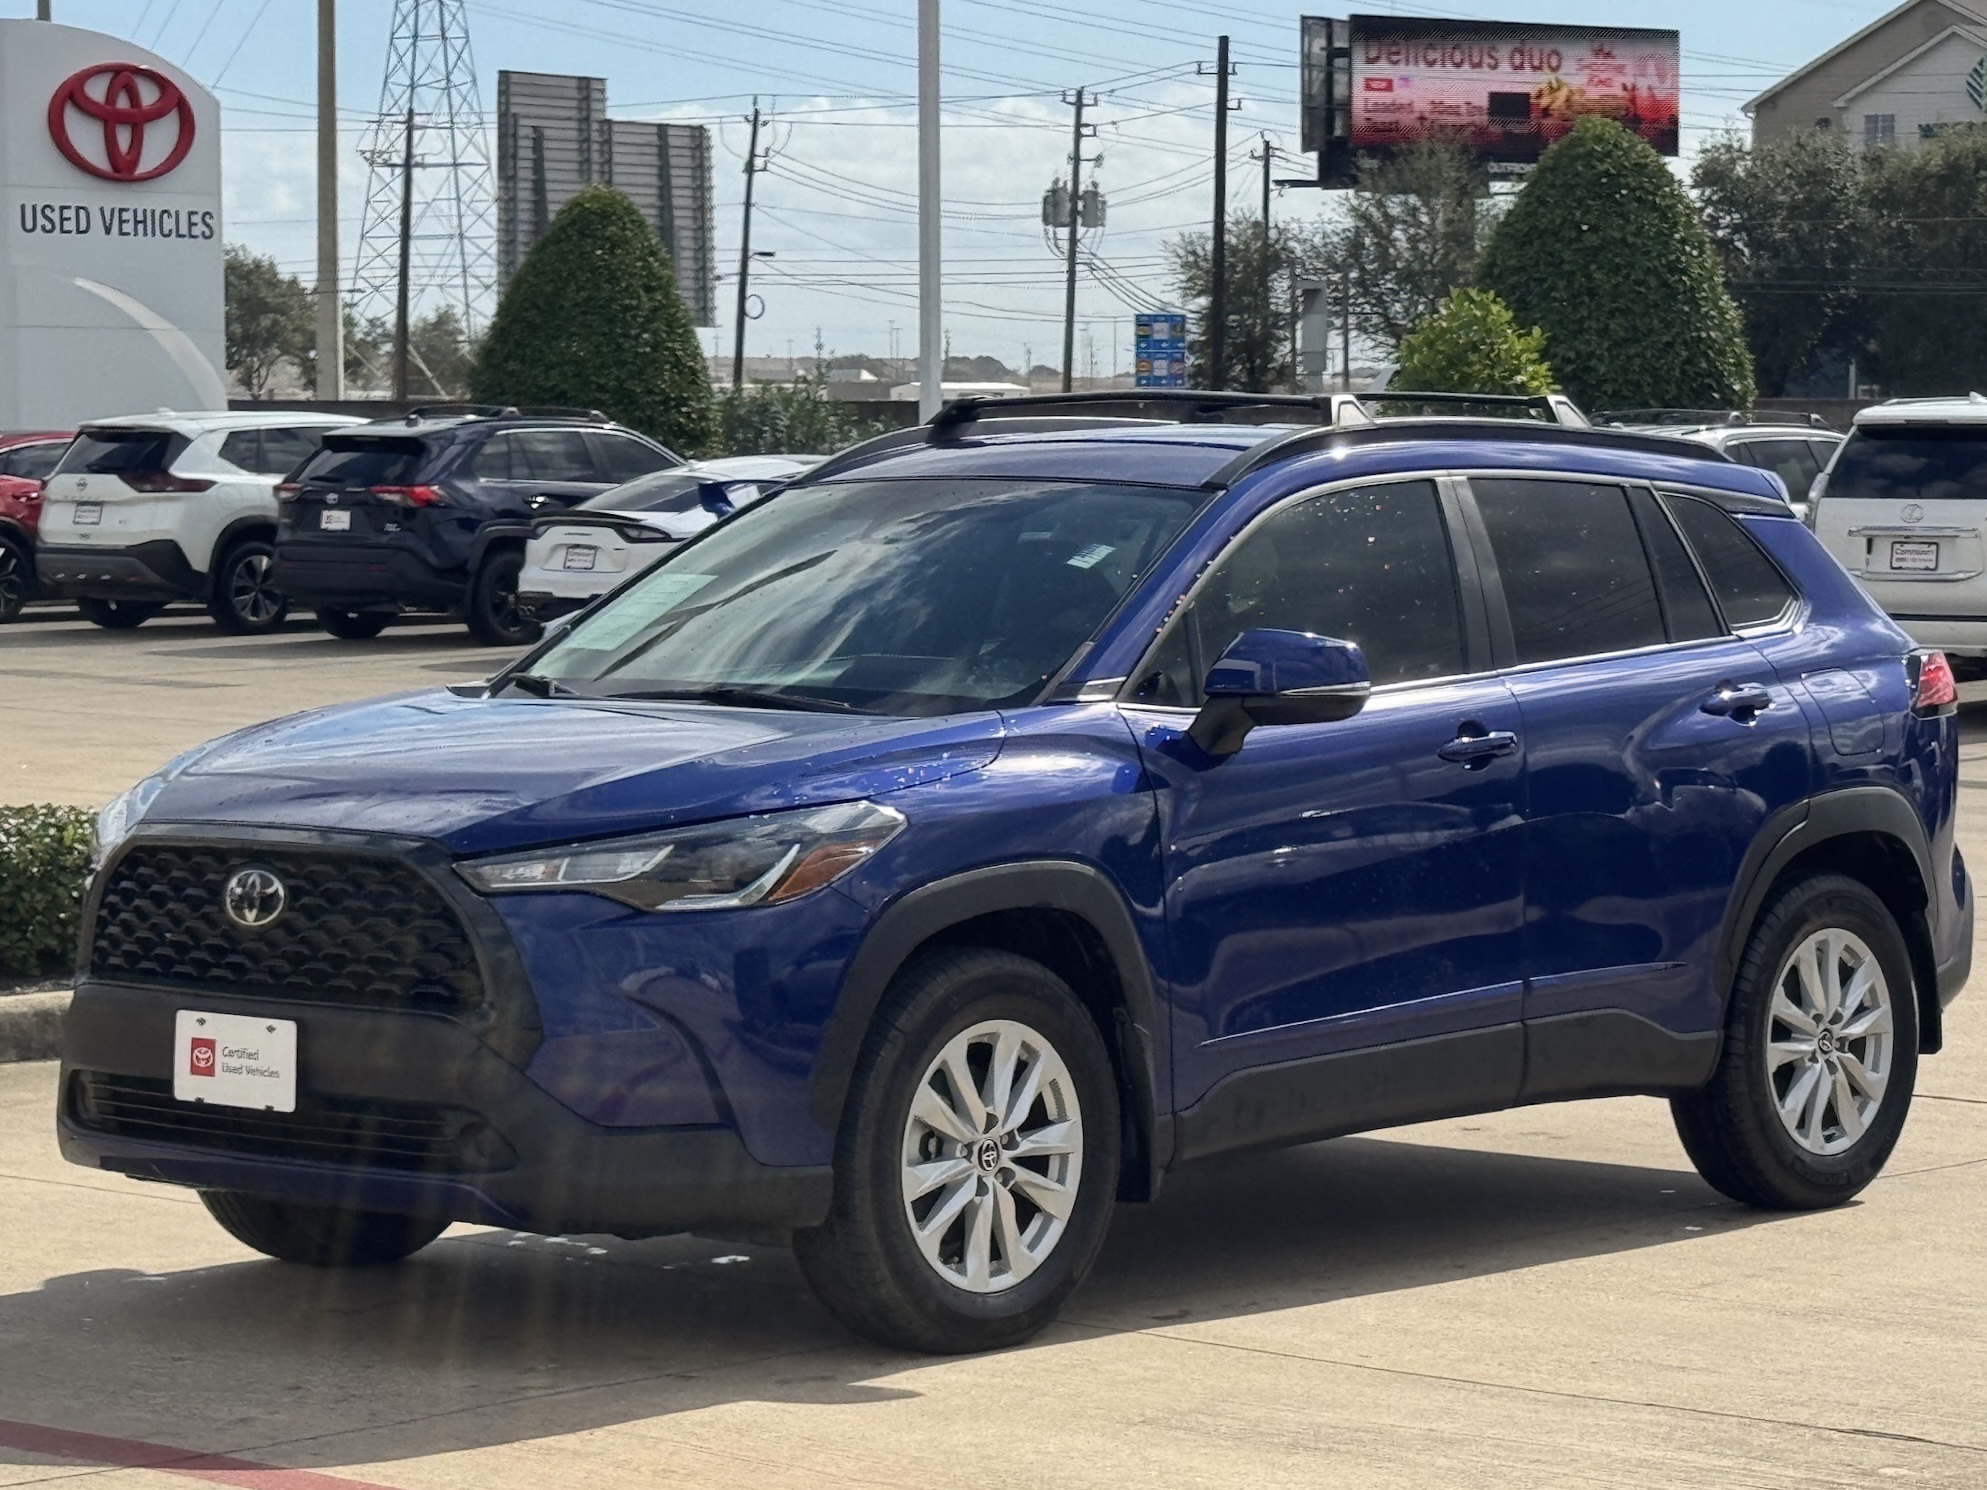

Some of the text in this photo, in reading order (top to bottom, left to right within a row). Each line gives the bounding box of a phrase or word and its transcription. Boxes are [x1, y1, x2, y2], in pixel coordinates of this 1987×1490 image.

[1364, 40, 1563, 73] Delicious duo
[20, 203, 214, 240] USED VEHICLES
[222, 1046, 260, 1061] Certified
[222, 1062, 280, 1079] Used Vehicles
